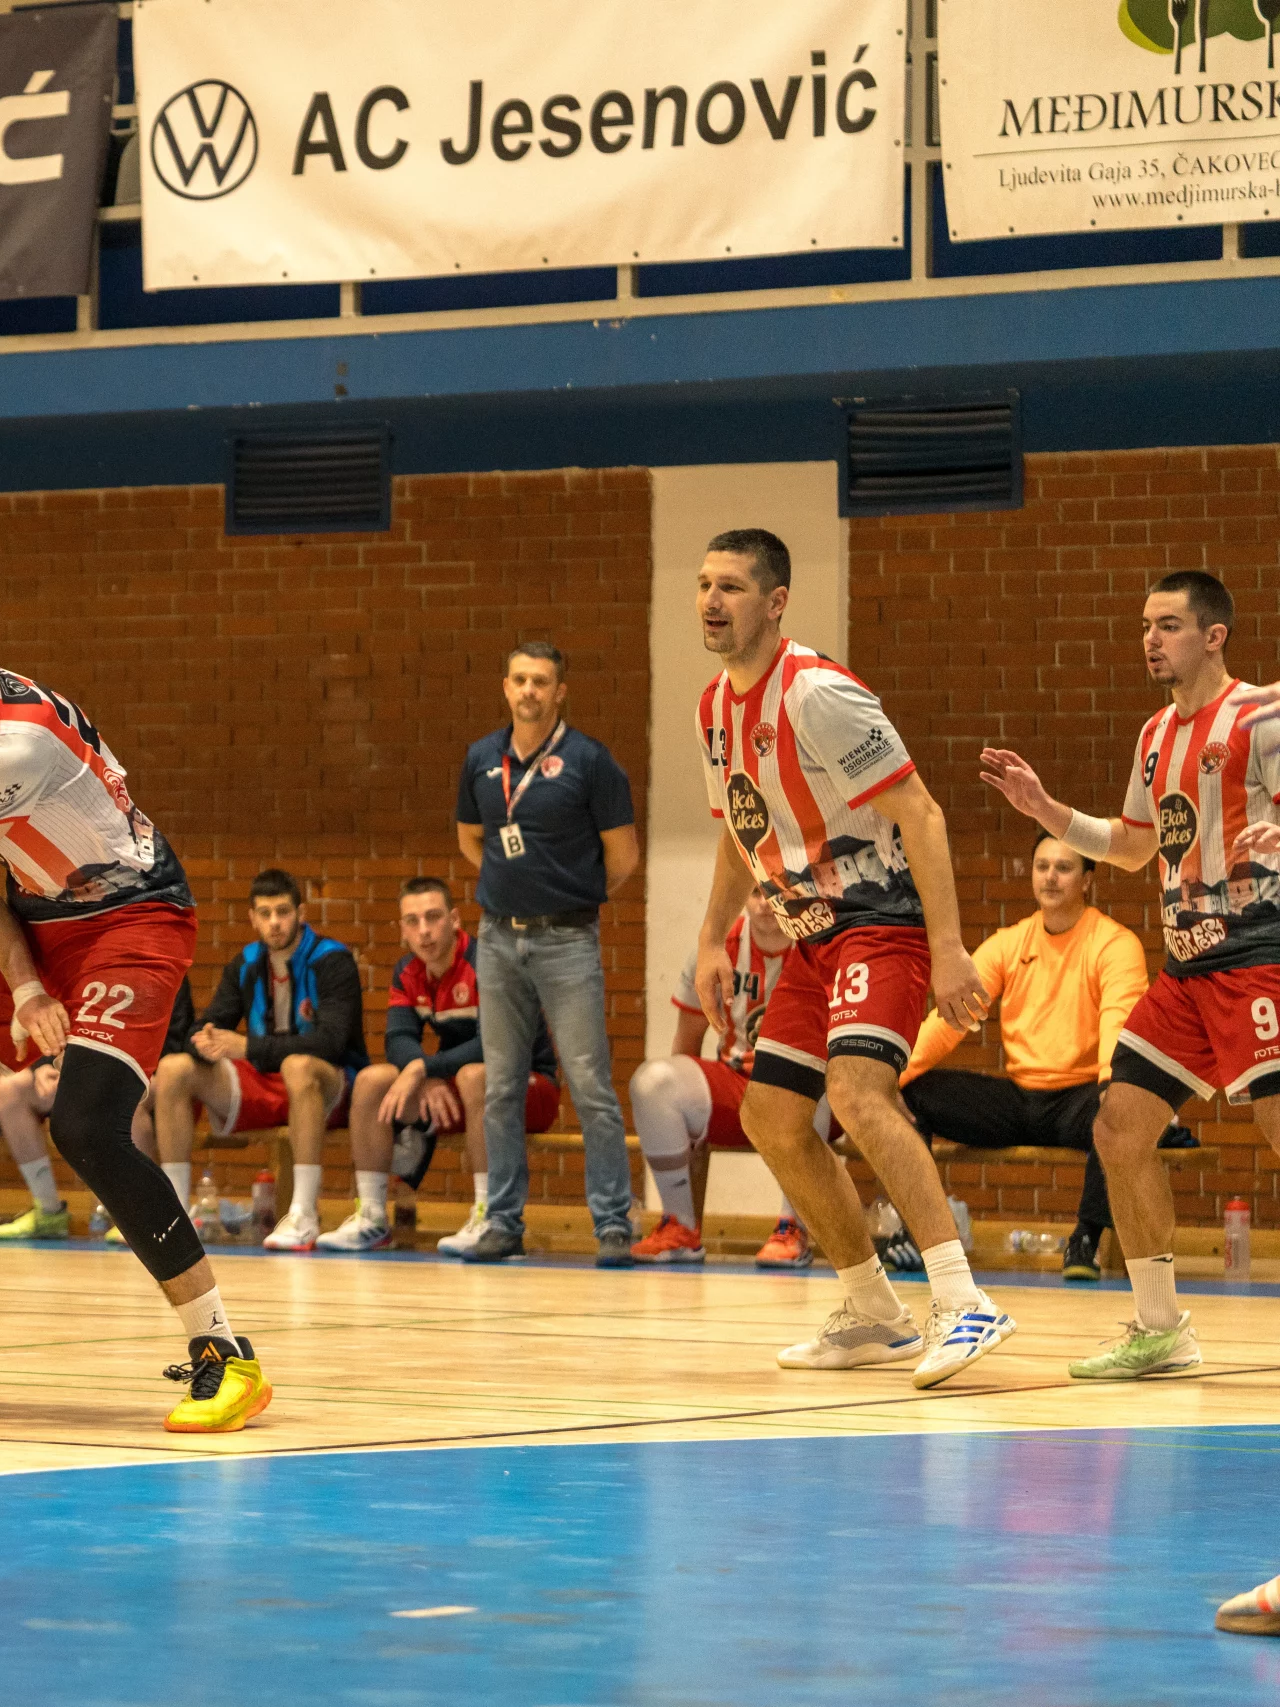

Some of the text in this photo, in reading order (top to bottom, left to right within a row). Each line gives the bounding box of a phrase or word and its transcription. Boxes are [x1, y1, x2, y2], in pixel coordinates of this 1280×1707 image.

[292, 44, 878, 175] AC Jesenović
[999, 164, 1081, 192] Ljudevita
[1088, 161, 1131, 185] Gaja
[1138, 158, 1166, 178] 35,
[837, 740, 873, 766] WIENER
[843, 738, 891, 774] OSIGURANJE
[1144, 751, 1160, 788] 9
[507, 835, 521, 854] B
[1160, 827, 1193, 848] Cakes
[828, 962, 869, 1009] 13
[75, 981, 134, 1029] 22
[830, 1009, 858, 1023] FOTEX
[1251, 996, 1279, 1040] 9
